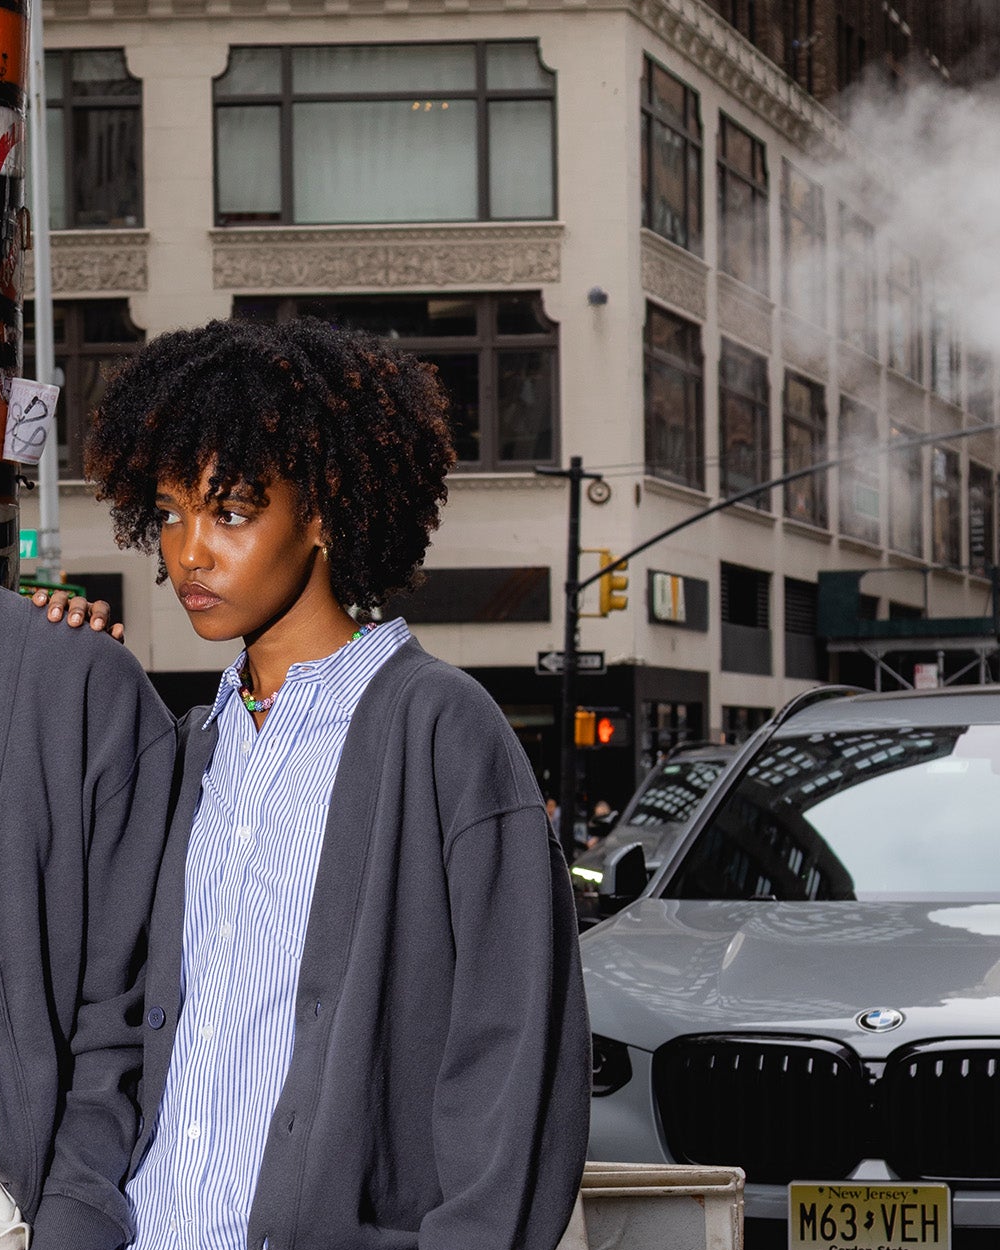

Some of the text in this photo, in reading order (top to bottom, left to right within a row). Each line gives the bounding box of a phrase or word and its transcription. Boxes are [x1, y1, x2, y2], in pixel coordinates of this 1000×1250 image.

[828, 1186, 910, 1202] New Jersey
[800, 1203, 939, 1243] M63 VEH
